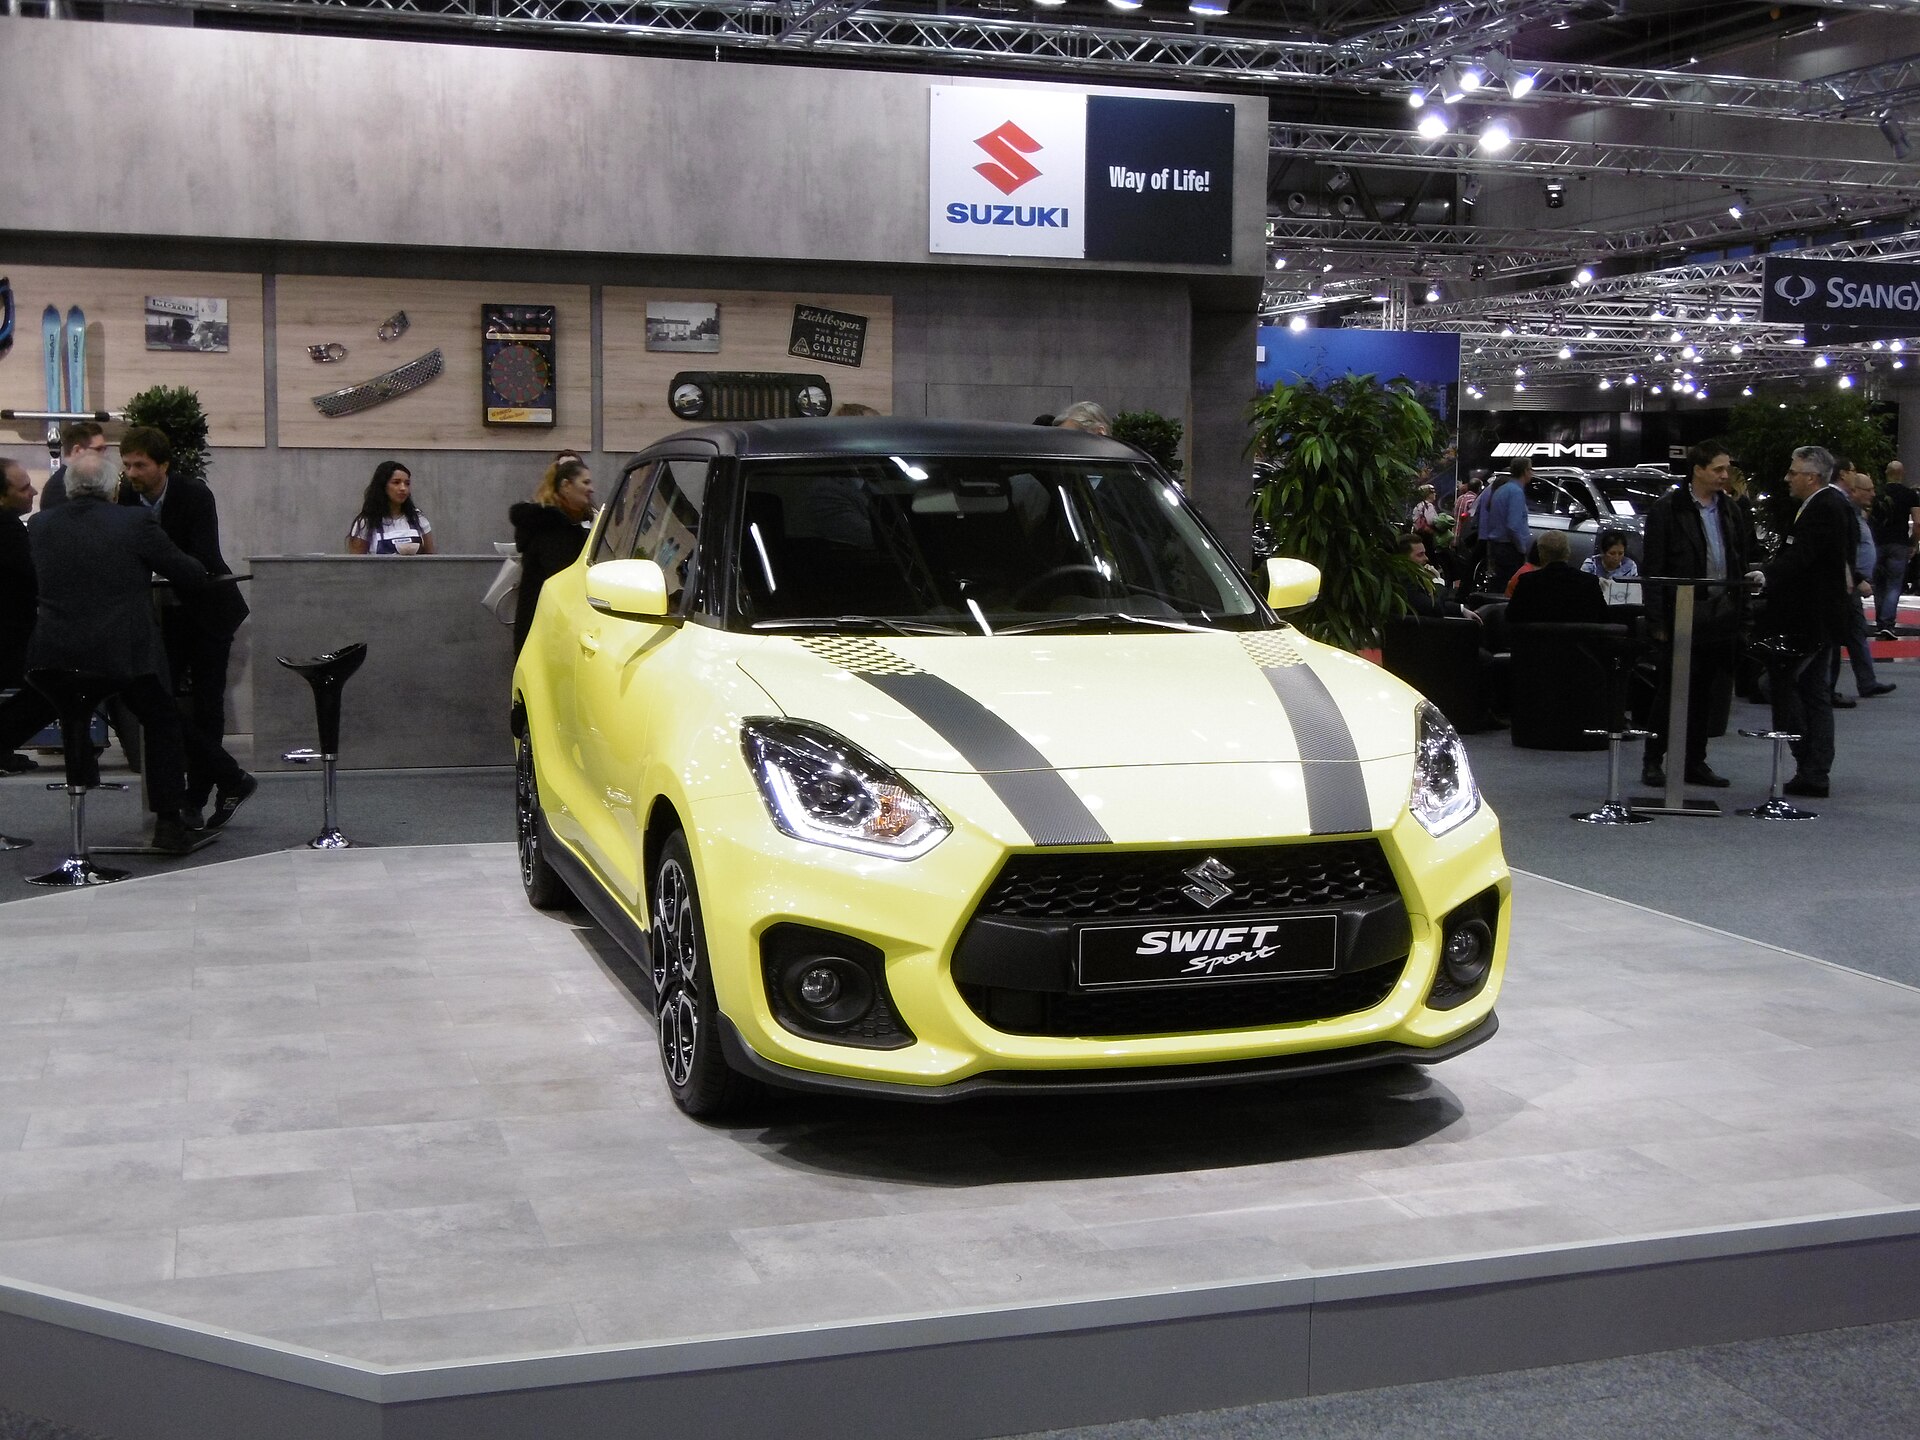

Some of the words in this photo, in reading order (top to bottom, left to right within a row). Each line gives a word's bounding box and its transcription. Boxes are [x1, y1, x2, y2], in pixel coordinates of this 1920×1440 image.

[1109, 166, 1146, 193] Way
[1150, 168, 1170, 190] of
[1173, 169, 1210, 192] Life!
[946, 203, 1069, 227] SUZUKI
[798, 310, 861, 330] Lichtbogen
[814, 334, 858, 349] FARBIGE
[1529, 443, 1607, 458] AMG
[1136, 925, 1279, 955] SWIFT
[1181, 945, 1281, 974] Sport
